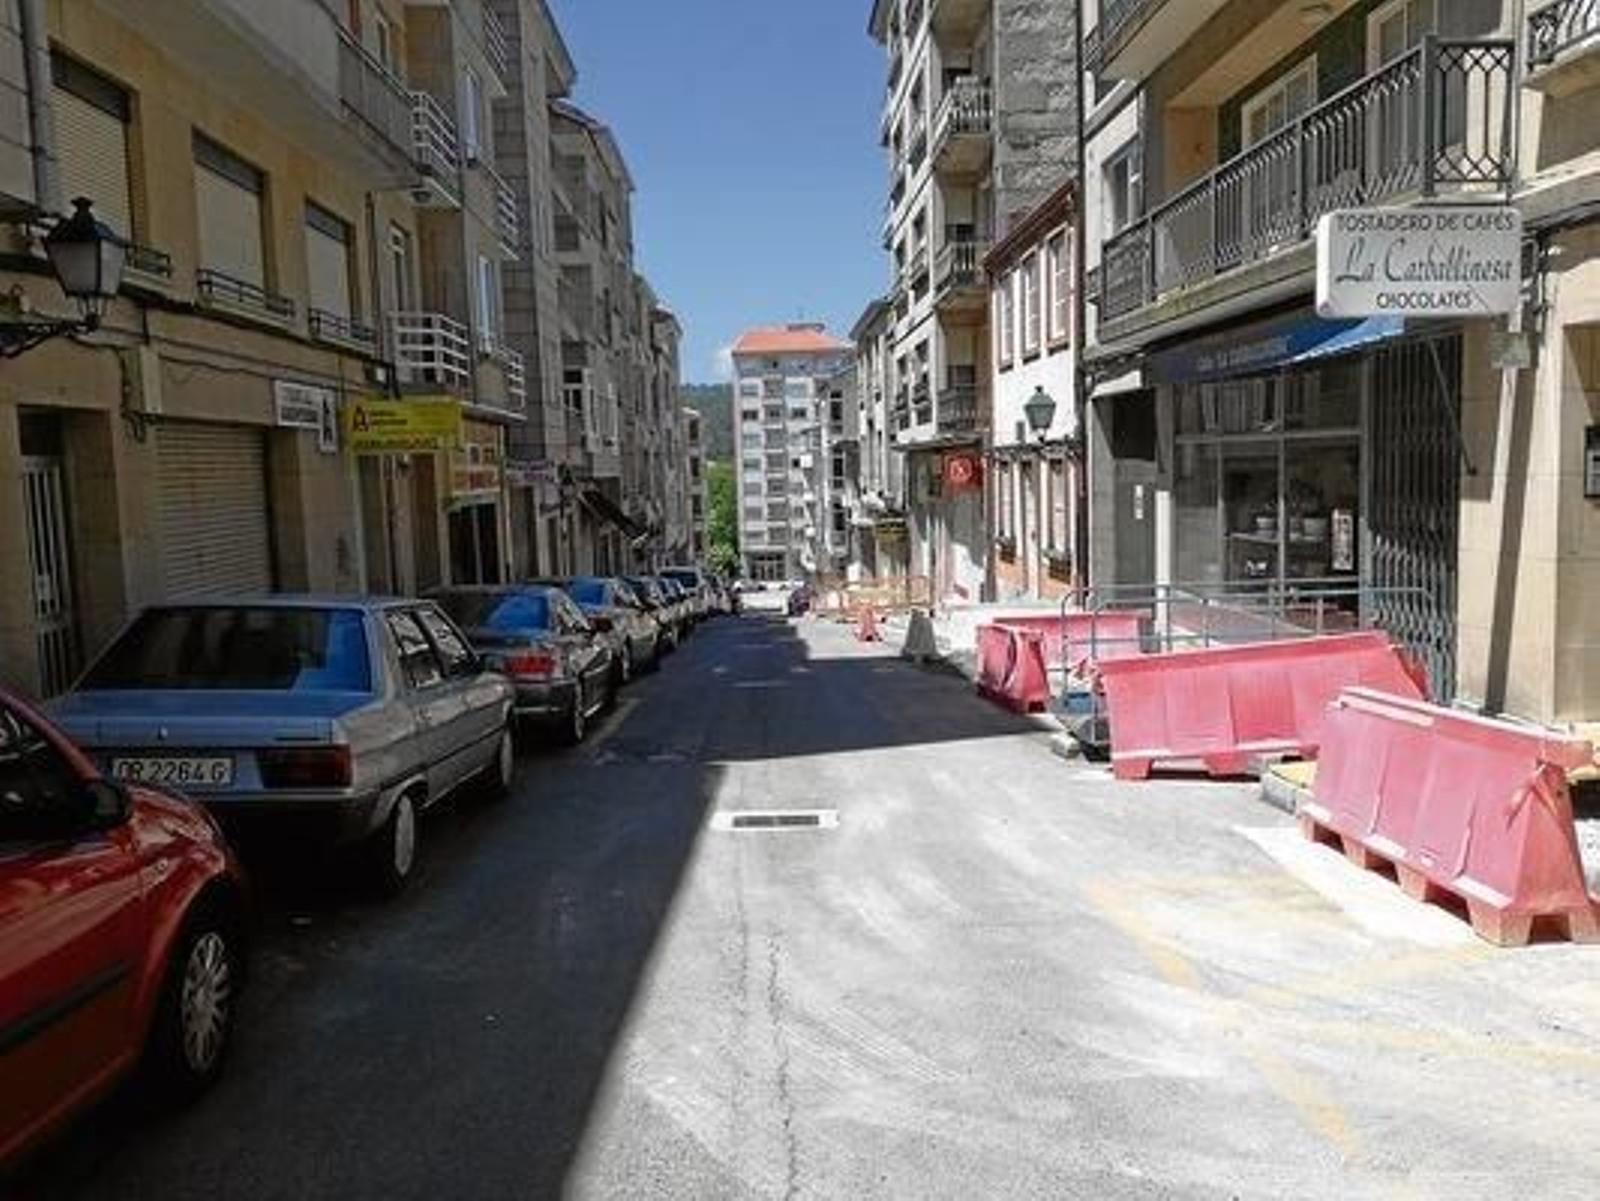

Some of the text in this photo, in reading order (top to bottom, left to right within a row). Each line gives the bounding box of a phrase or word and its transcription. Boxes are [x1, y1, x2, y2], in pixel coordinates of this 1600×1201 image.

[1337, 213, 1432, 232] TOSTADERO
[1436, 213, 1459, 231] DE
[1376, 291, 1472, 310] CHOCOLATES
[147, 760, 204, 783] 2264
[210, 761, 227, 782] G
